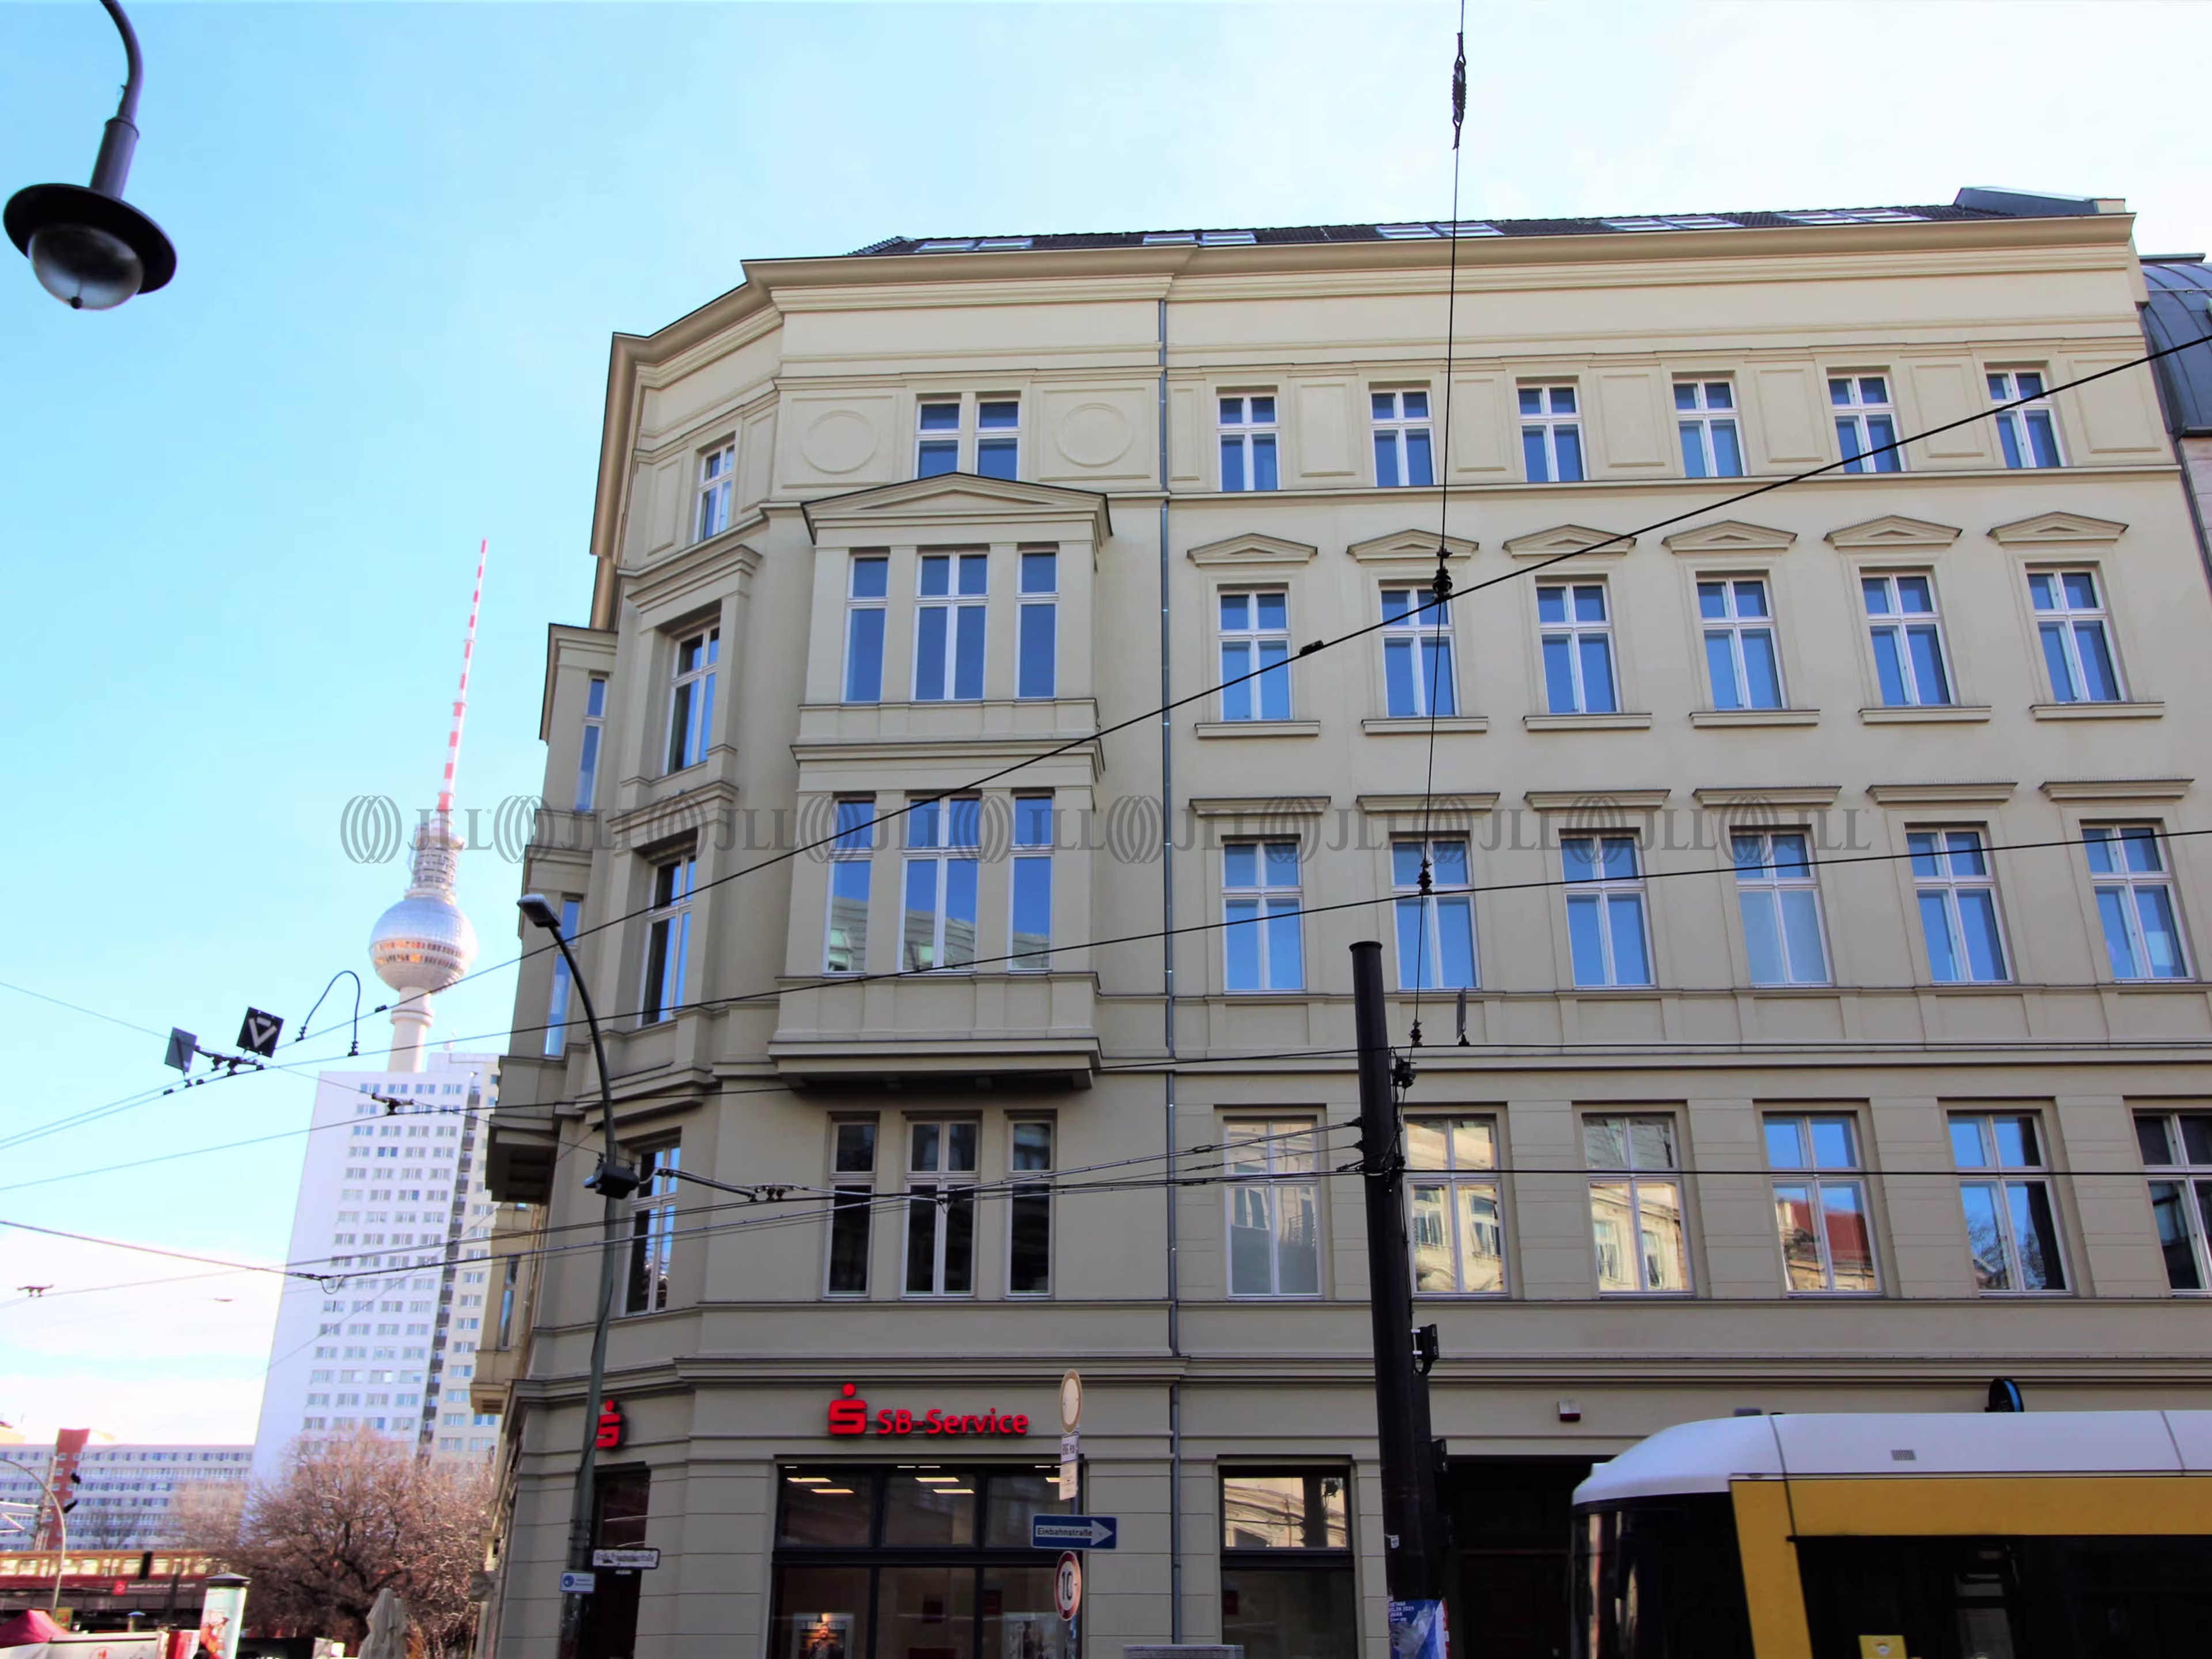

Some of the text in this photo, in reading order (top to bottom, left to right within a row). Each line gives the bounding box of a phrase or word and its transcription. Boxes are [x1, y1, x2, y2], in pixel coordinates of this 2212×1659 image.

[876, 1407, 1029, 1434] SB-Service
[1037, 1527, 1093, 1537] Einbahnstraße
[1062, 1571, 1073, 1600] 10
